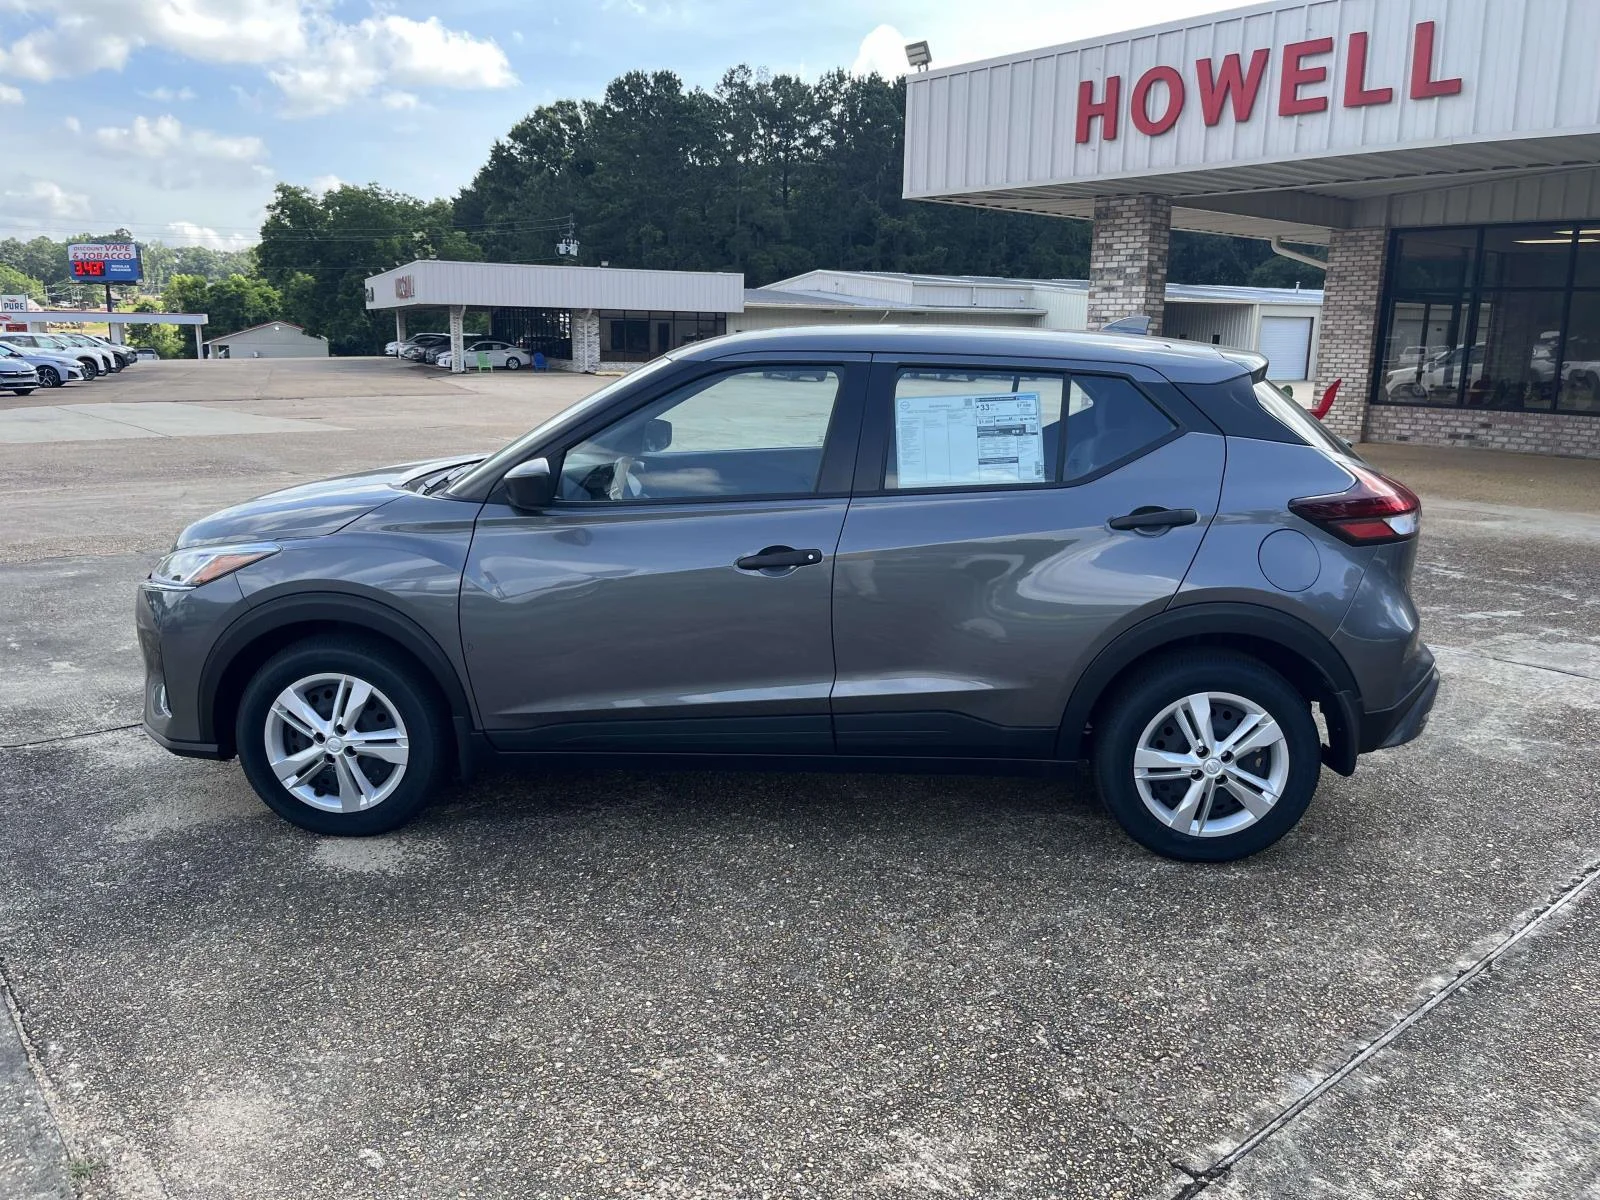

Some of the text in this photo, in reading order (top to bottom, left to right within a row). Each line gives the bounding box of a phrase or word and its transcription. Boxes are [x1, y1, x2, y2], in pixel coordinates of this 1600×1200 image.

[1075, 20, 1463, 144] HOWELL
[104, 244, 131, 252] VAPE
[82, 252, 132, 260] TOBACCO
[3, 302, 24, 310] PURE
